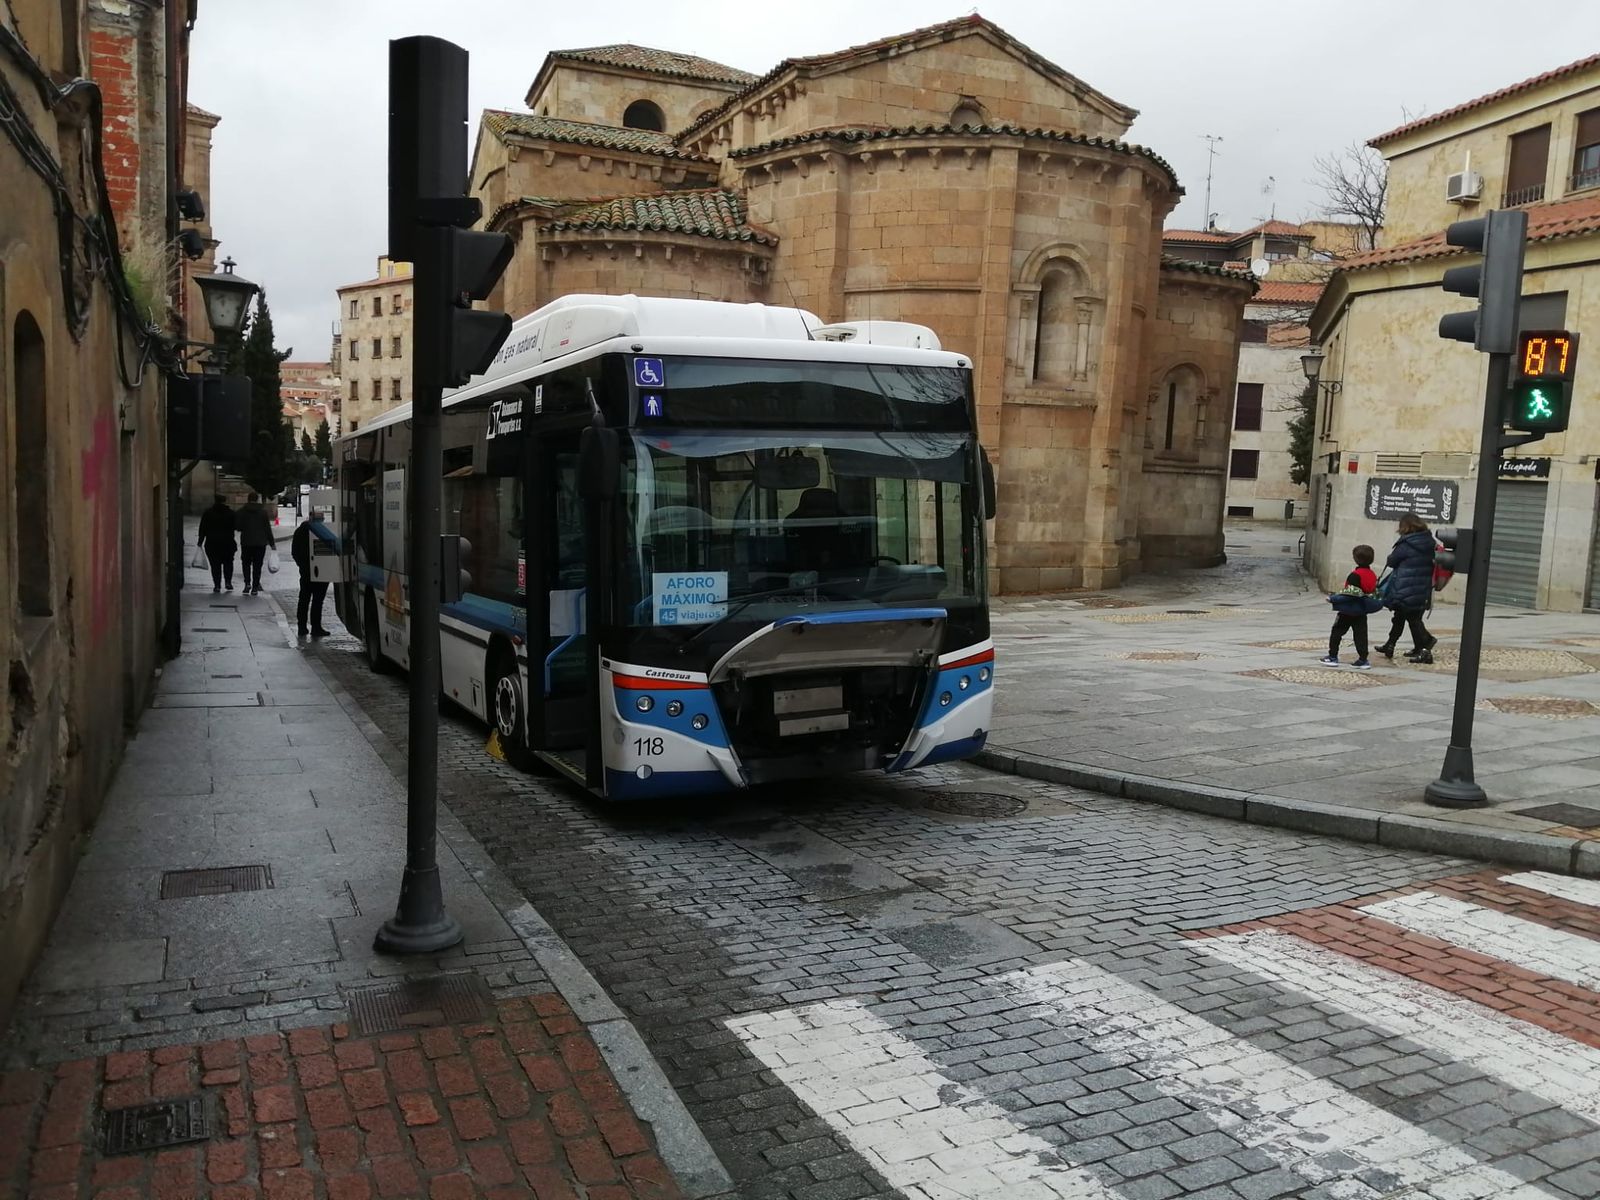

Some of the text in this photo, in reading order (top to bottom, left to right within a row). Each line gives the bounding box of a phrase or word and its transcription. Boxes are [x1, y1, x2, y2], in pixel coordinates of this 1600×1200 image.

[503, 344, 516, 363] gas
[516, 329, 540, 354] natural
[1524, 338, 1569, 375] 87
[1503, 460, 1537, 473] Escapada
[1391, 481, 1431, 497] La Escapada
[666, 577, 715, 589] AFORO
[680, 609, 721, 621] viajeros
[645, 669, 691, 680] Castrosua
[634, 737, 664, 756] 118
